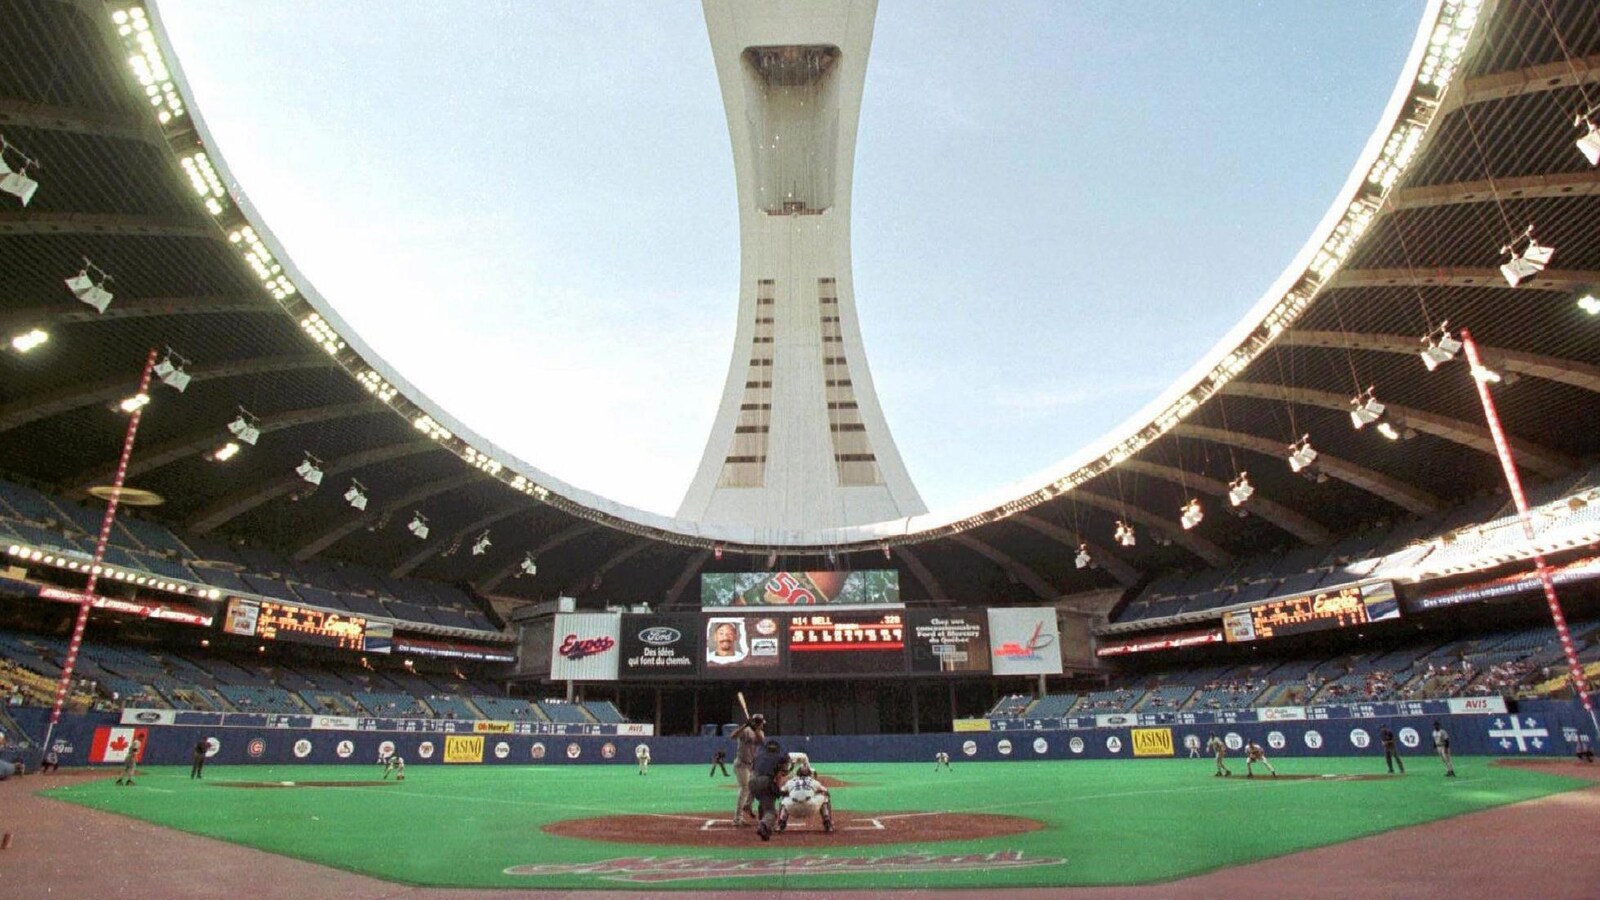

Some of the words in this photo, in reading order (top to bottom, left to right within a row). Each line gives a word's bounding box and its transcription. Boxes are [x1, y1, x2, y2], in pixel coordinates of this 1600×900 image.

[647, 630, 673, 641] Ford
[559, 634, 614, 659] Expos
[644, 647, 657, 656] Des
[657, 647, 675, 656] idées
[628, 656, 639, 667] qui
[640, 656, 655, 665] font
[655, 656, 665, 665] du
[666, 656, 692, 665] chemin.
[1465, 700, 1488, 709] AVIS
[488, 723, 510, 732] Henry!
[1135, 730, 1170, 750] CASINO
[1404, 735, 1416, 744] 42
[447, 737, 481, 758] CASINO
